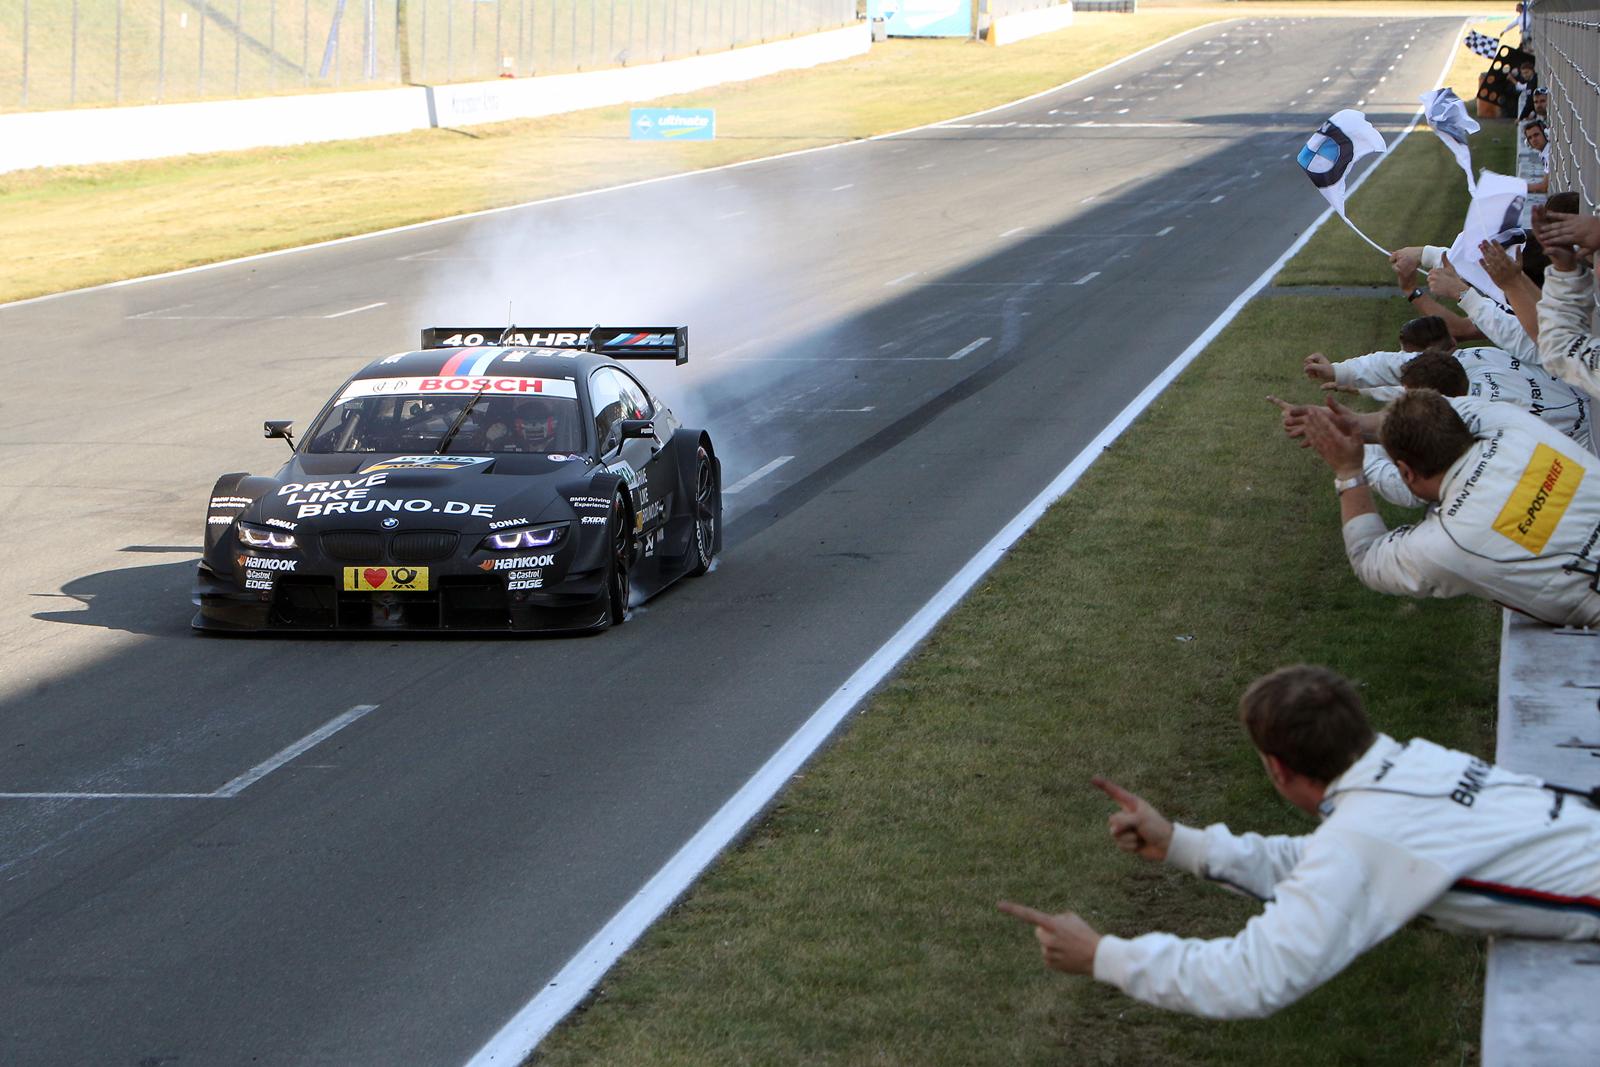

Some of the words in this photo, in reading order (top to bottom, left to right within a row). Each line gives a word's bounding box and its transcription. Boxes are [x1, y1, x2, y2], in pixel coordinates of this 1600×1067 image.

[442, 333, 484, 347] 40
[418, 378, 543, 393] BOSCH
[277, 473, 389, 496] DRIVE
[1448, 489, 1471, 517] BMW
[1465, 461, 1488, 488] Team
[286, 488, 370, 506] LIKE
[588, 496, 611, 504] Driving
[297, 499, 497, 519] BRUNO.DE
[266, 518, 298, 530] SONAX
[489, 518, 528, 529] SONAX
[516, 569, 541, 579] Castrol
[245, 580, 273, 589] EDGE
[508, 579, 543, 590] EDGE
